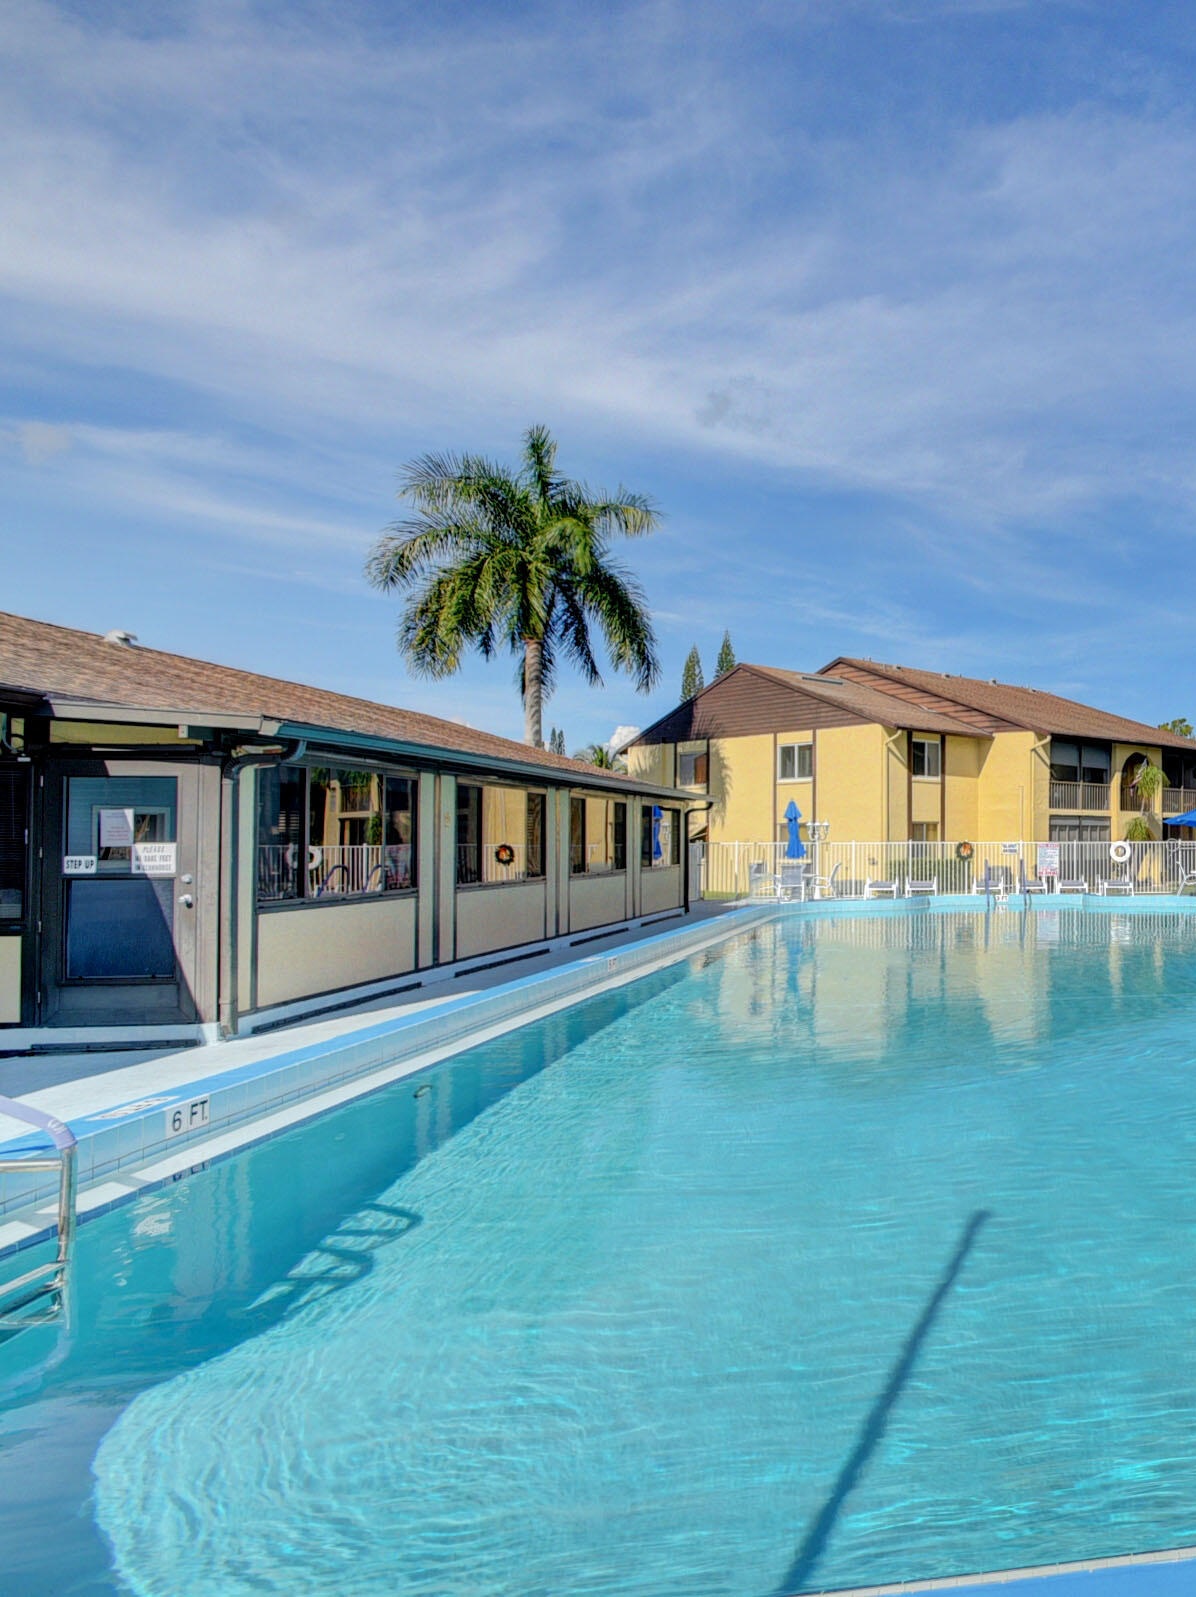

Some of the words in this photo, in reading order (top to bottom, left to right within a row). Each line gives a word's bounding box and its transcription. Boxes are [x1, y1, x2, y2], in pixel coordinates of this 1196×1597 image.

[66, 860, 82, 869] STEP
[85, 860, 94, 869] UP
[172, 1110, 182, 1132] 6
[190, 1099, 208, 1125] FT.
